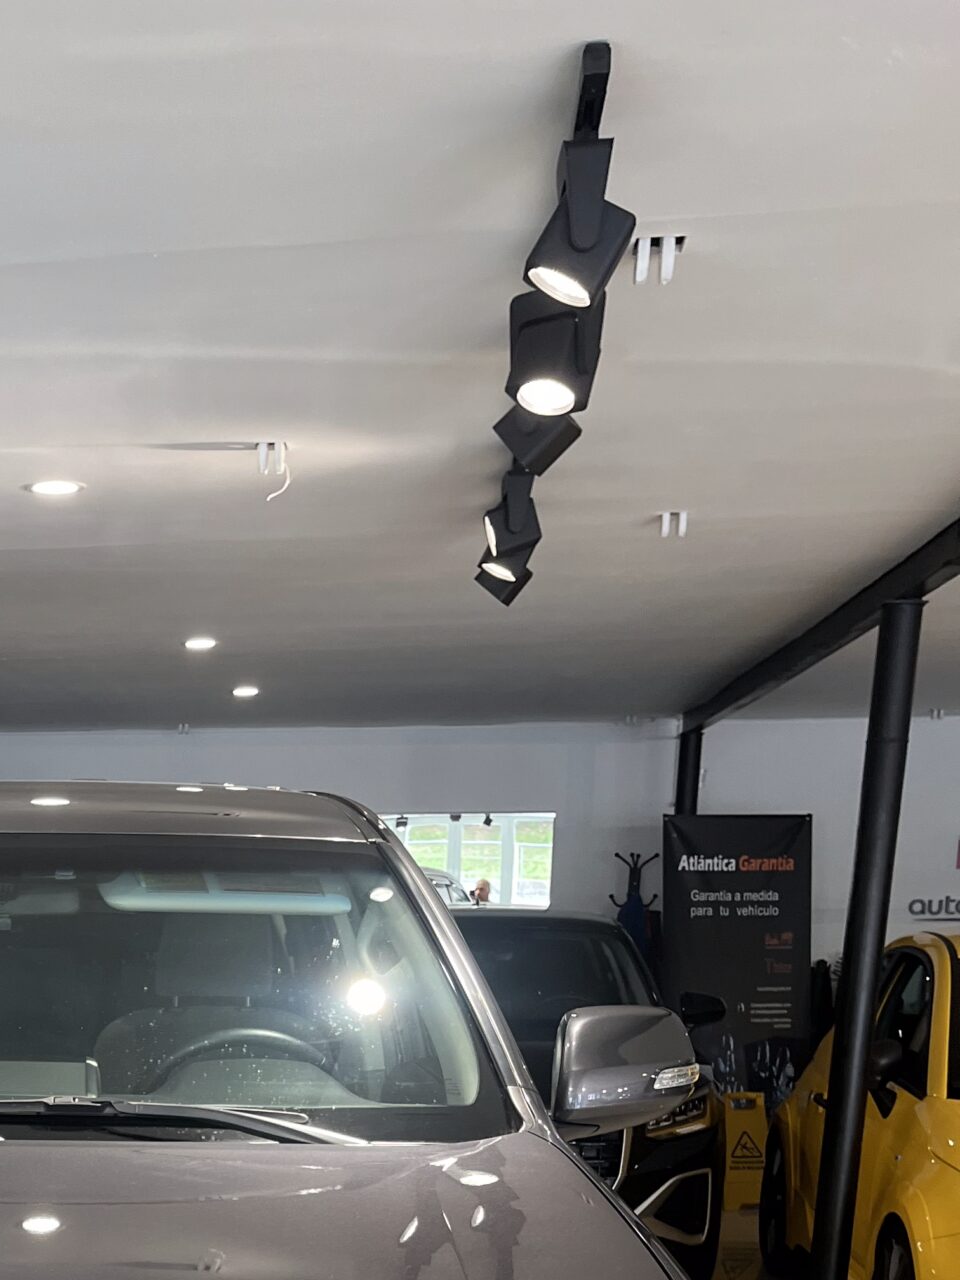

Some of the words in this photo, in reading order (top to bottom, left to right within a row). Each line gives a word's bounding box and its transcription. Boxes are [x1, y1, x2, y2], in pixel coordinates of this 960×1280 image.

[678, 854, 736, 871] Atlántica
[734, 892, 741, 901] a
[743, 890, 779, 901] medida
[690, 906, 713, 919] para
[720, 905, 730, 916] tu
